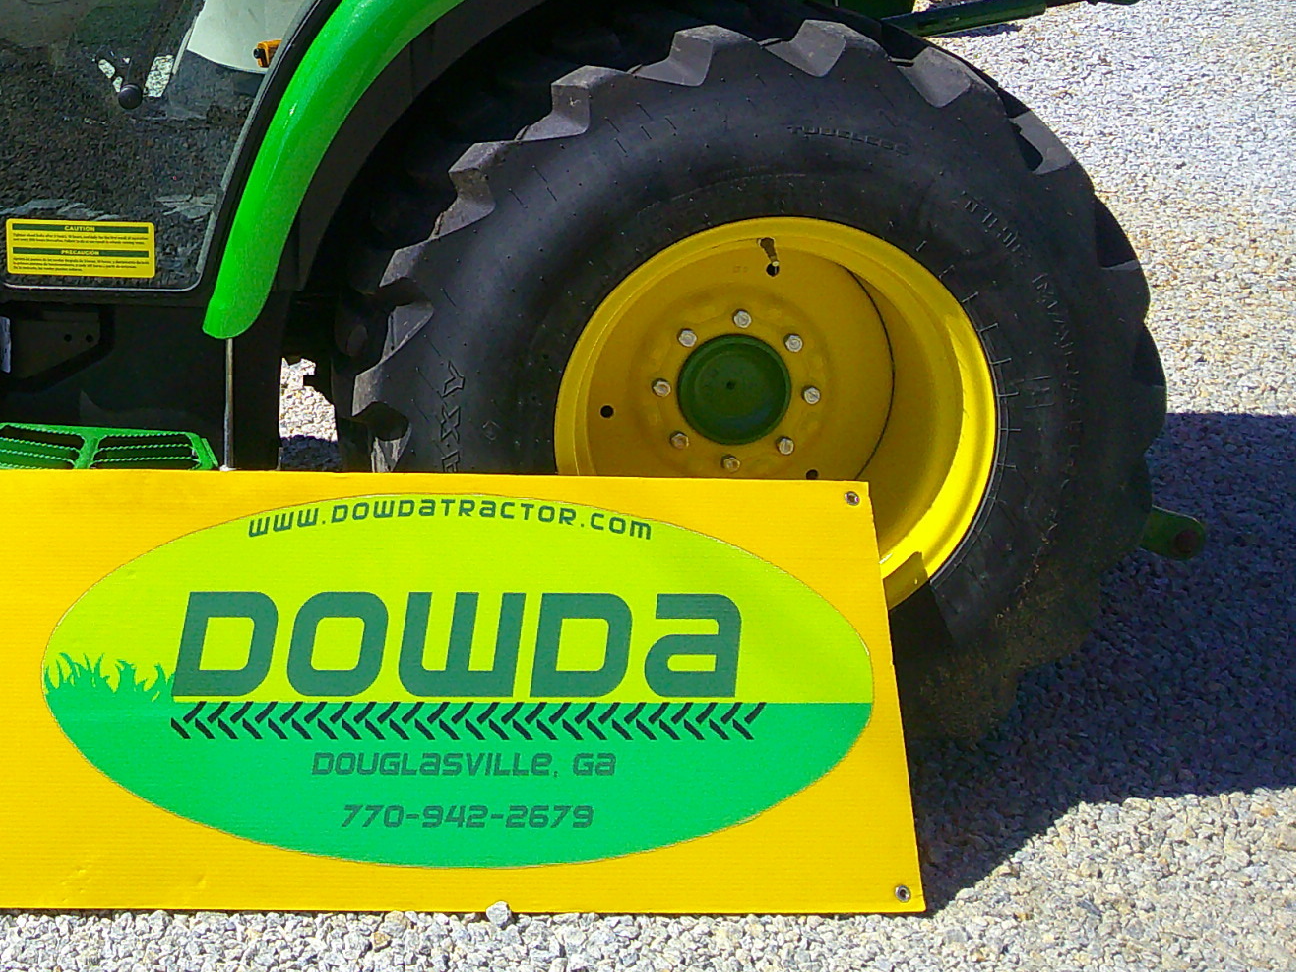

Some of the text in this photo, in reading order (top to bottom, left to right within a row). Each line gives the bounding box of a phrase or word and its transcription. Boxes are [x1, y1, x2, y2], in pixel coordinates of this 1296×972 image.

[171, 591, 743, 699] DOWDA
[572, 751, 617, 777] GA
[341, 804, 595, 830] 770-942-2679
